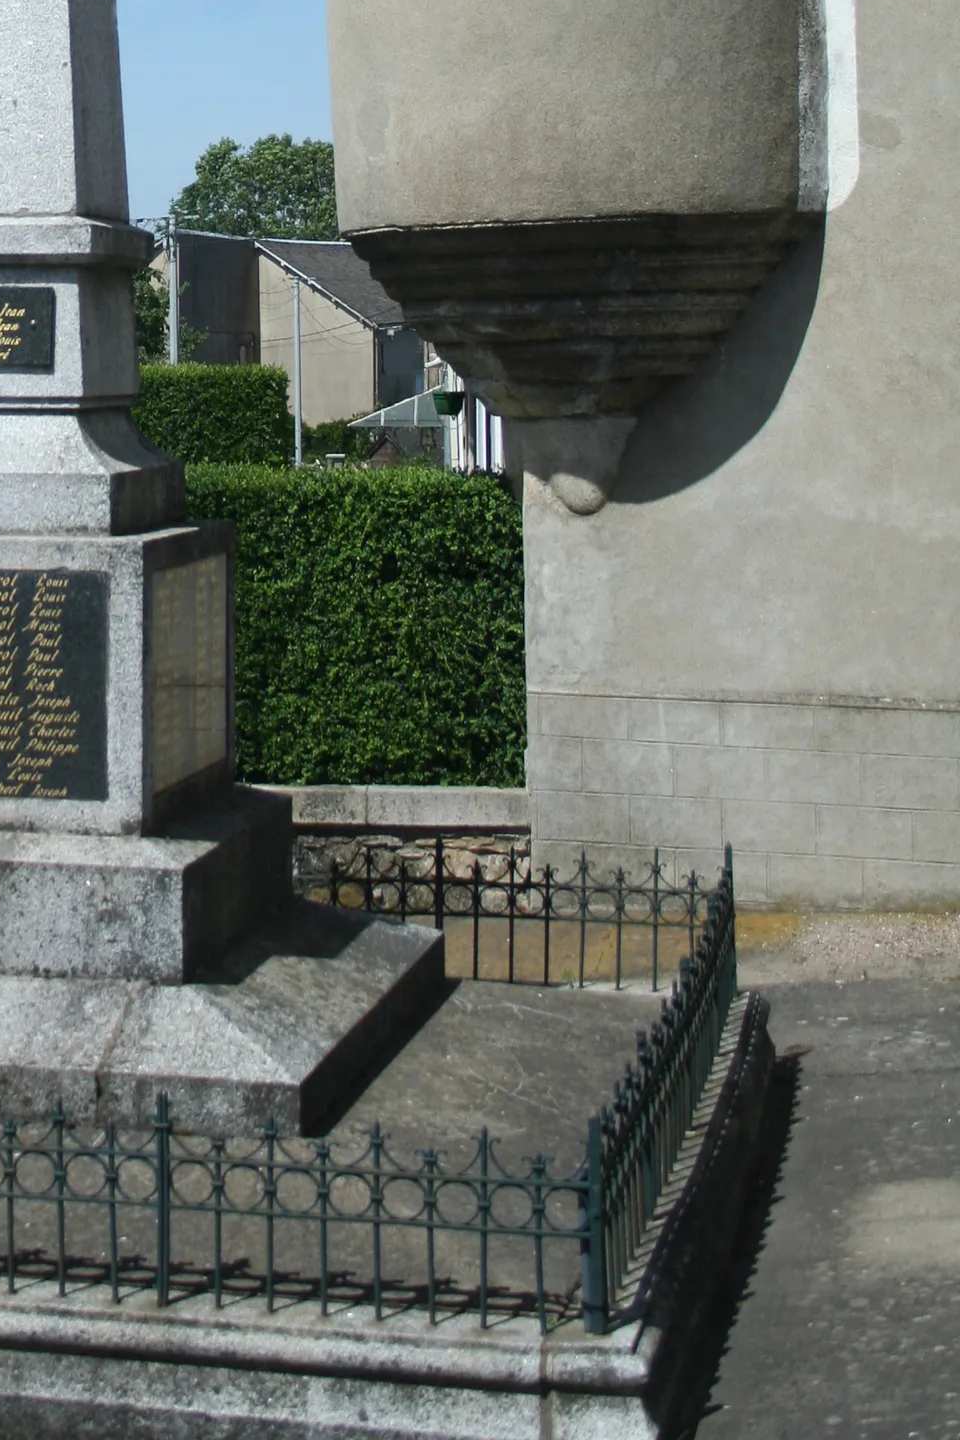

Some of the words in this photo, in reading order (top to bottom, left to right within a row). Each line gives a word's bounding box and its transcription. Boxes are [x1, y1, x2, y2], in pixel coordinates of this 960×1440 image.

[37, 574, 69, 587] Louis
[30, 603, 62, 617] Louis
[30, 633, 62, 646] Paul
[27, 648, 59, 661] Paul
[22, 663, 63, 677] Pierre
